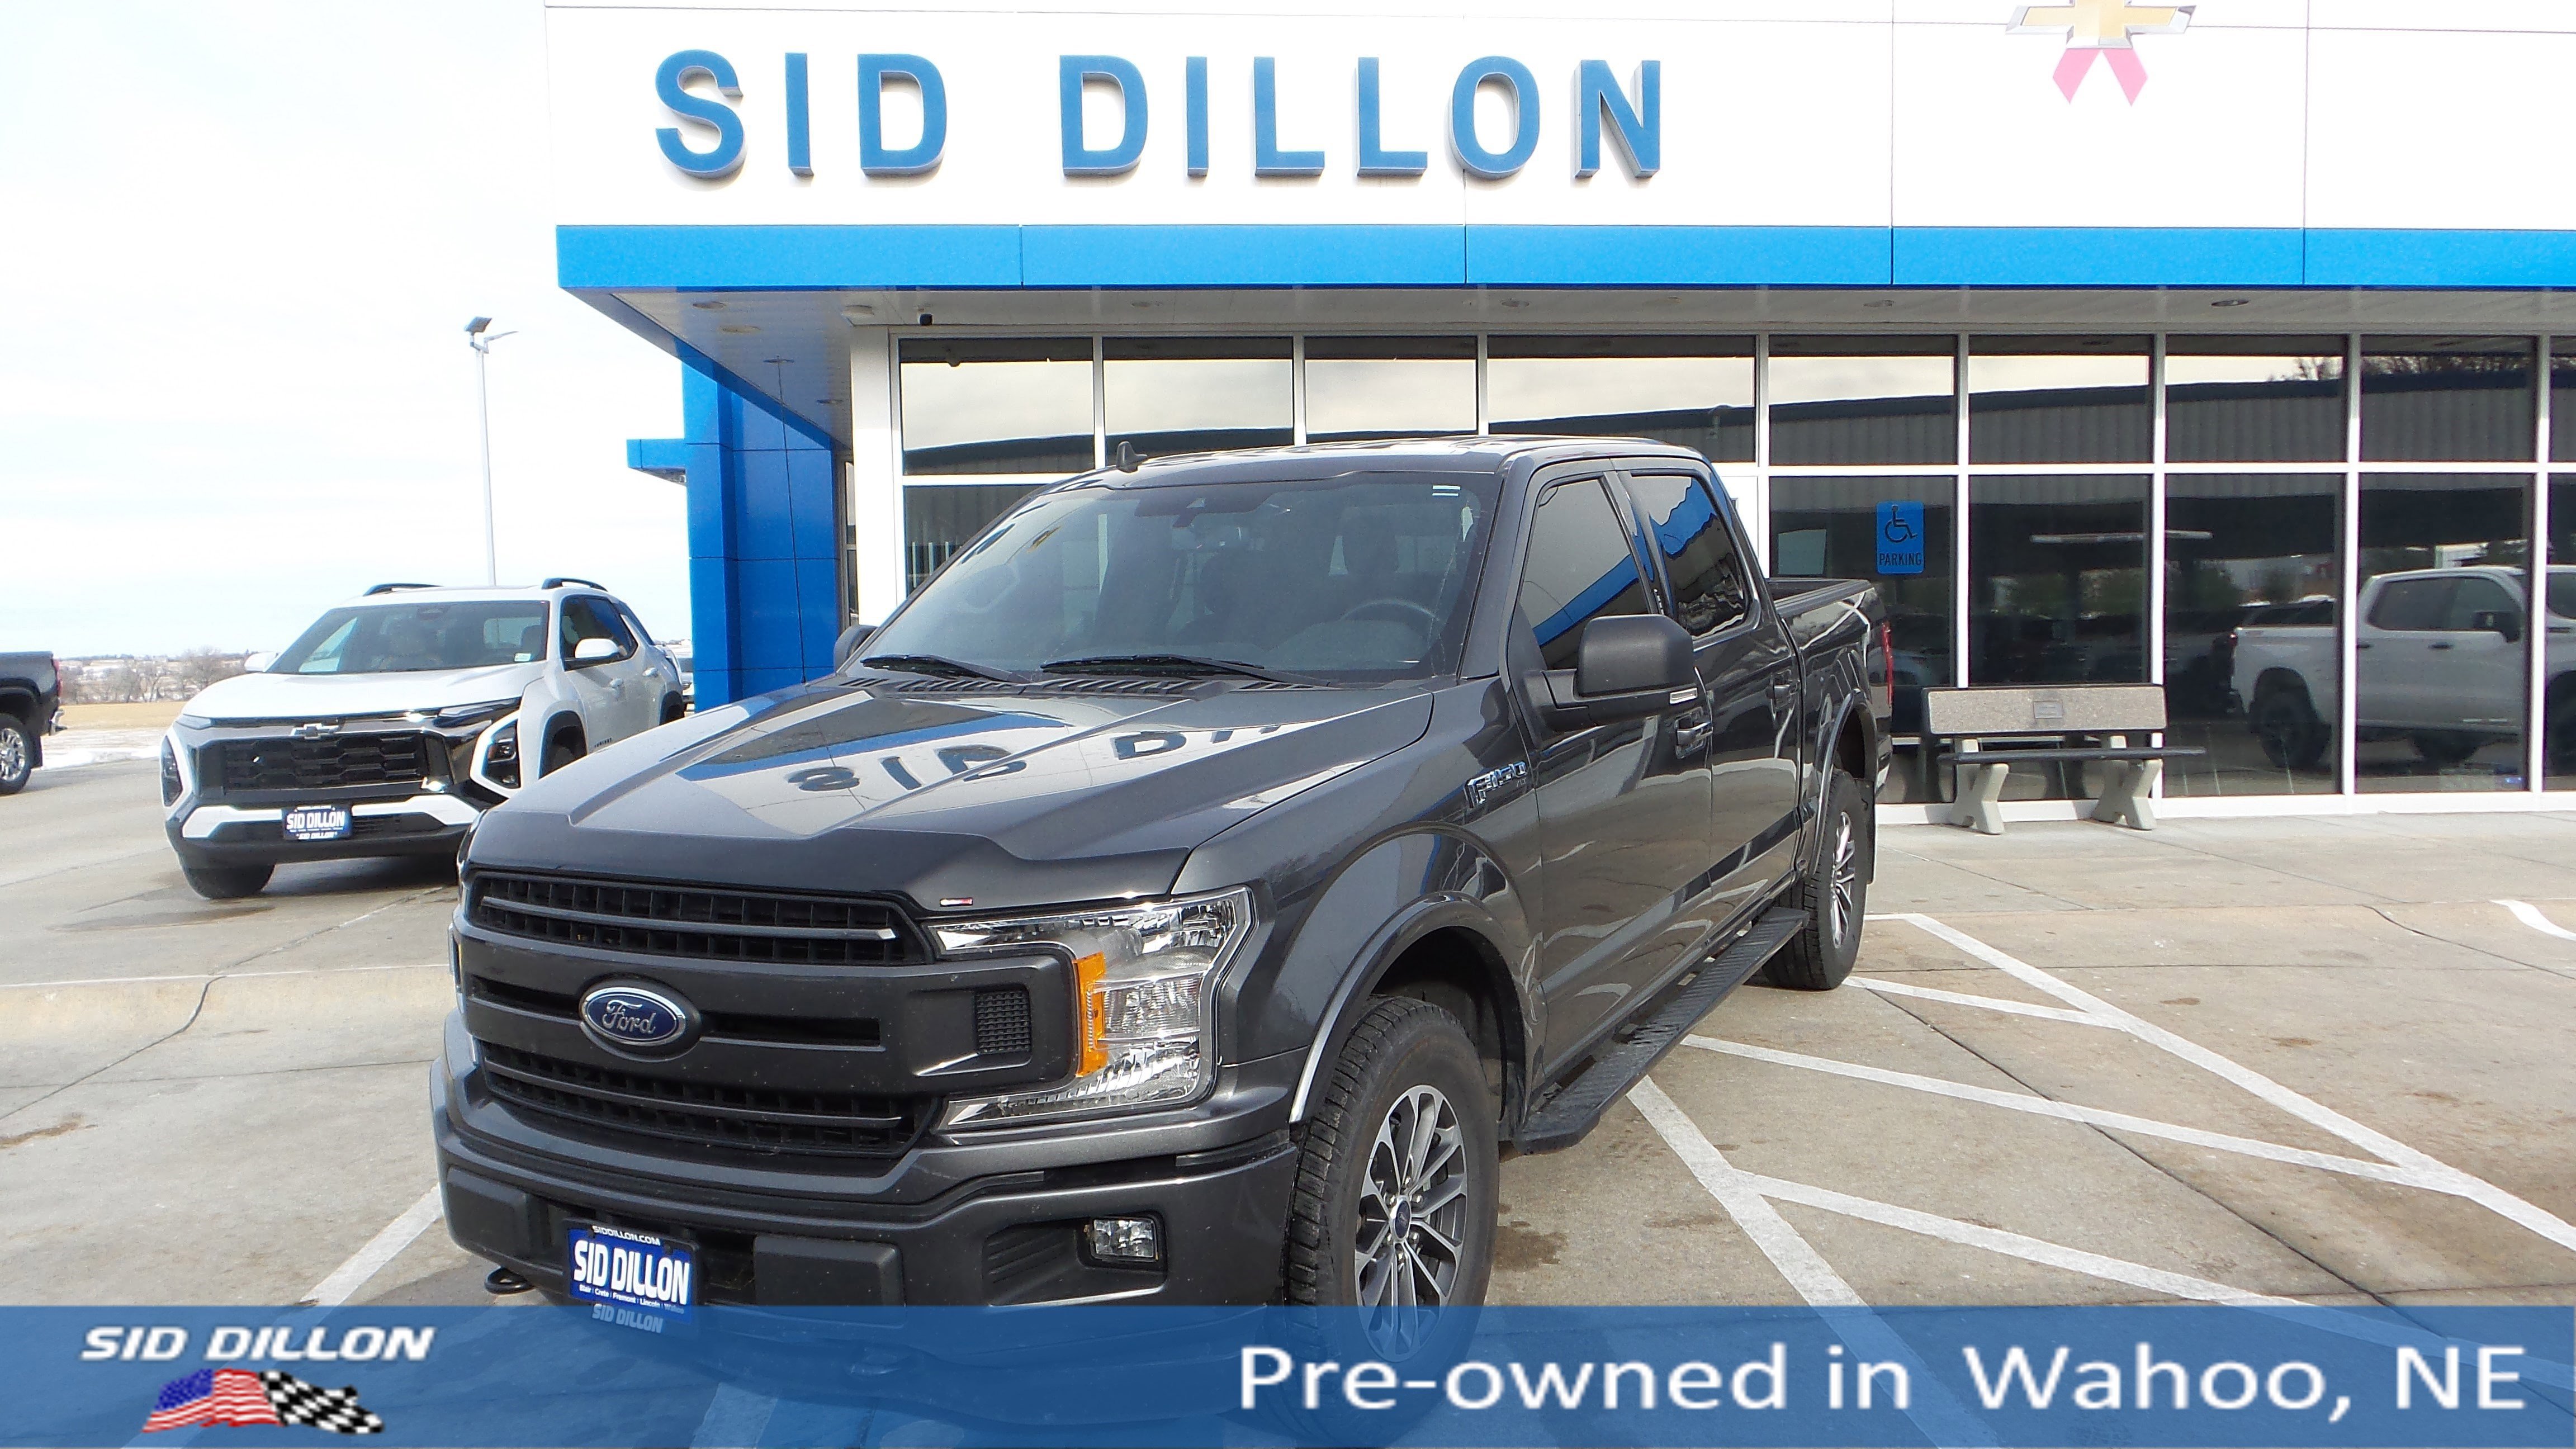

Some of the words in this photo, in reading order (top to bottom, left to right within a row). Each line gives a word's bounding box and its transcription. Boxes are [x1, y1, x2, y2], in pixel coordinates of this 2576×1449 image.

[655, 49, 947, 178] SID
[1060, 55, 1661, 178] DILLON
[1879, 552, 1922, 566] PARKING
[286, 813, 306, 830] SID
[307, 811, 345, 828] DILLON
[602, 1000, 657, 1034] Ford
[574, 1240, 608, 1287] SID
[611, 1248, 690, 1305] DILLON
[592, 1303, 614, 1322] SID
[616, 1309, 664, 1333] DILLON
